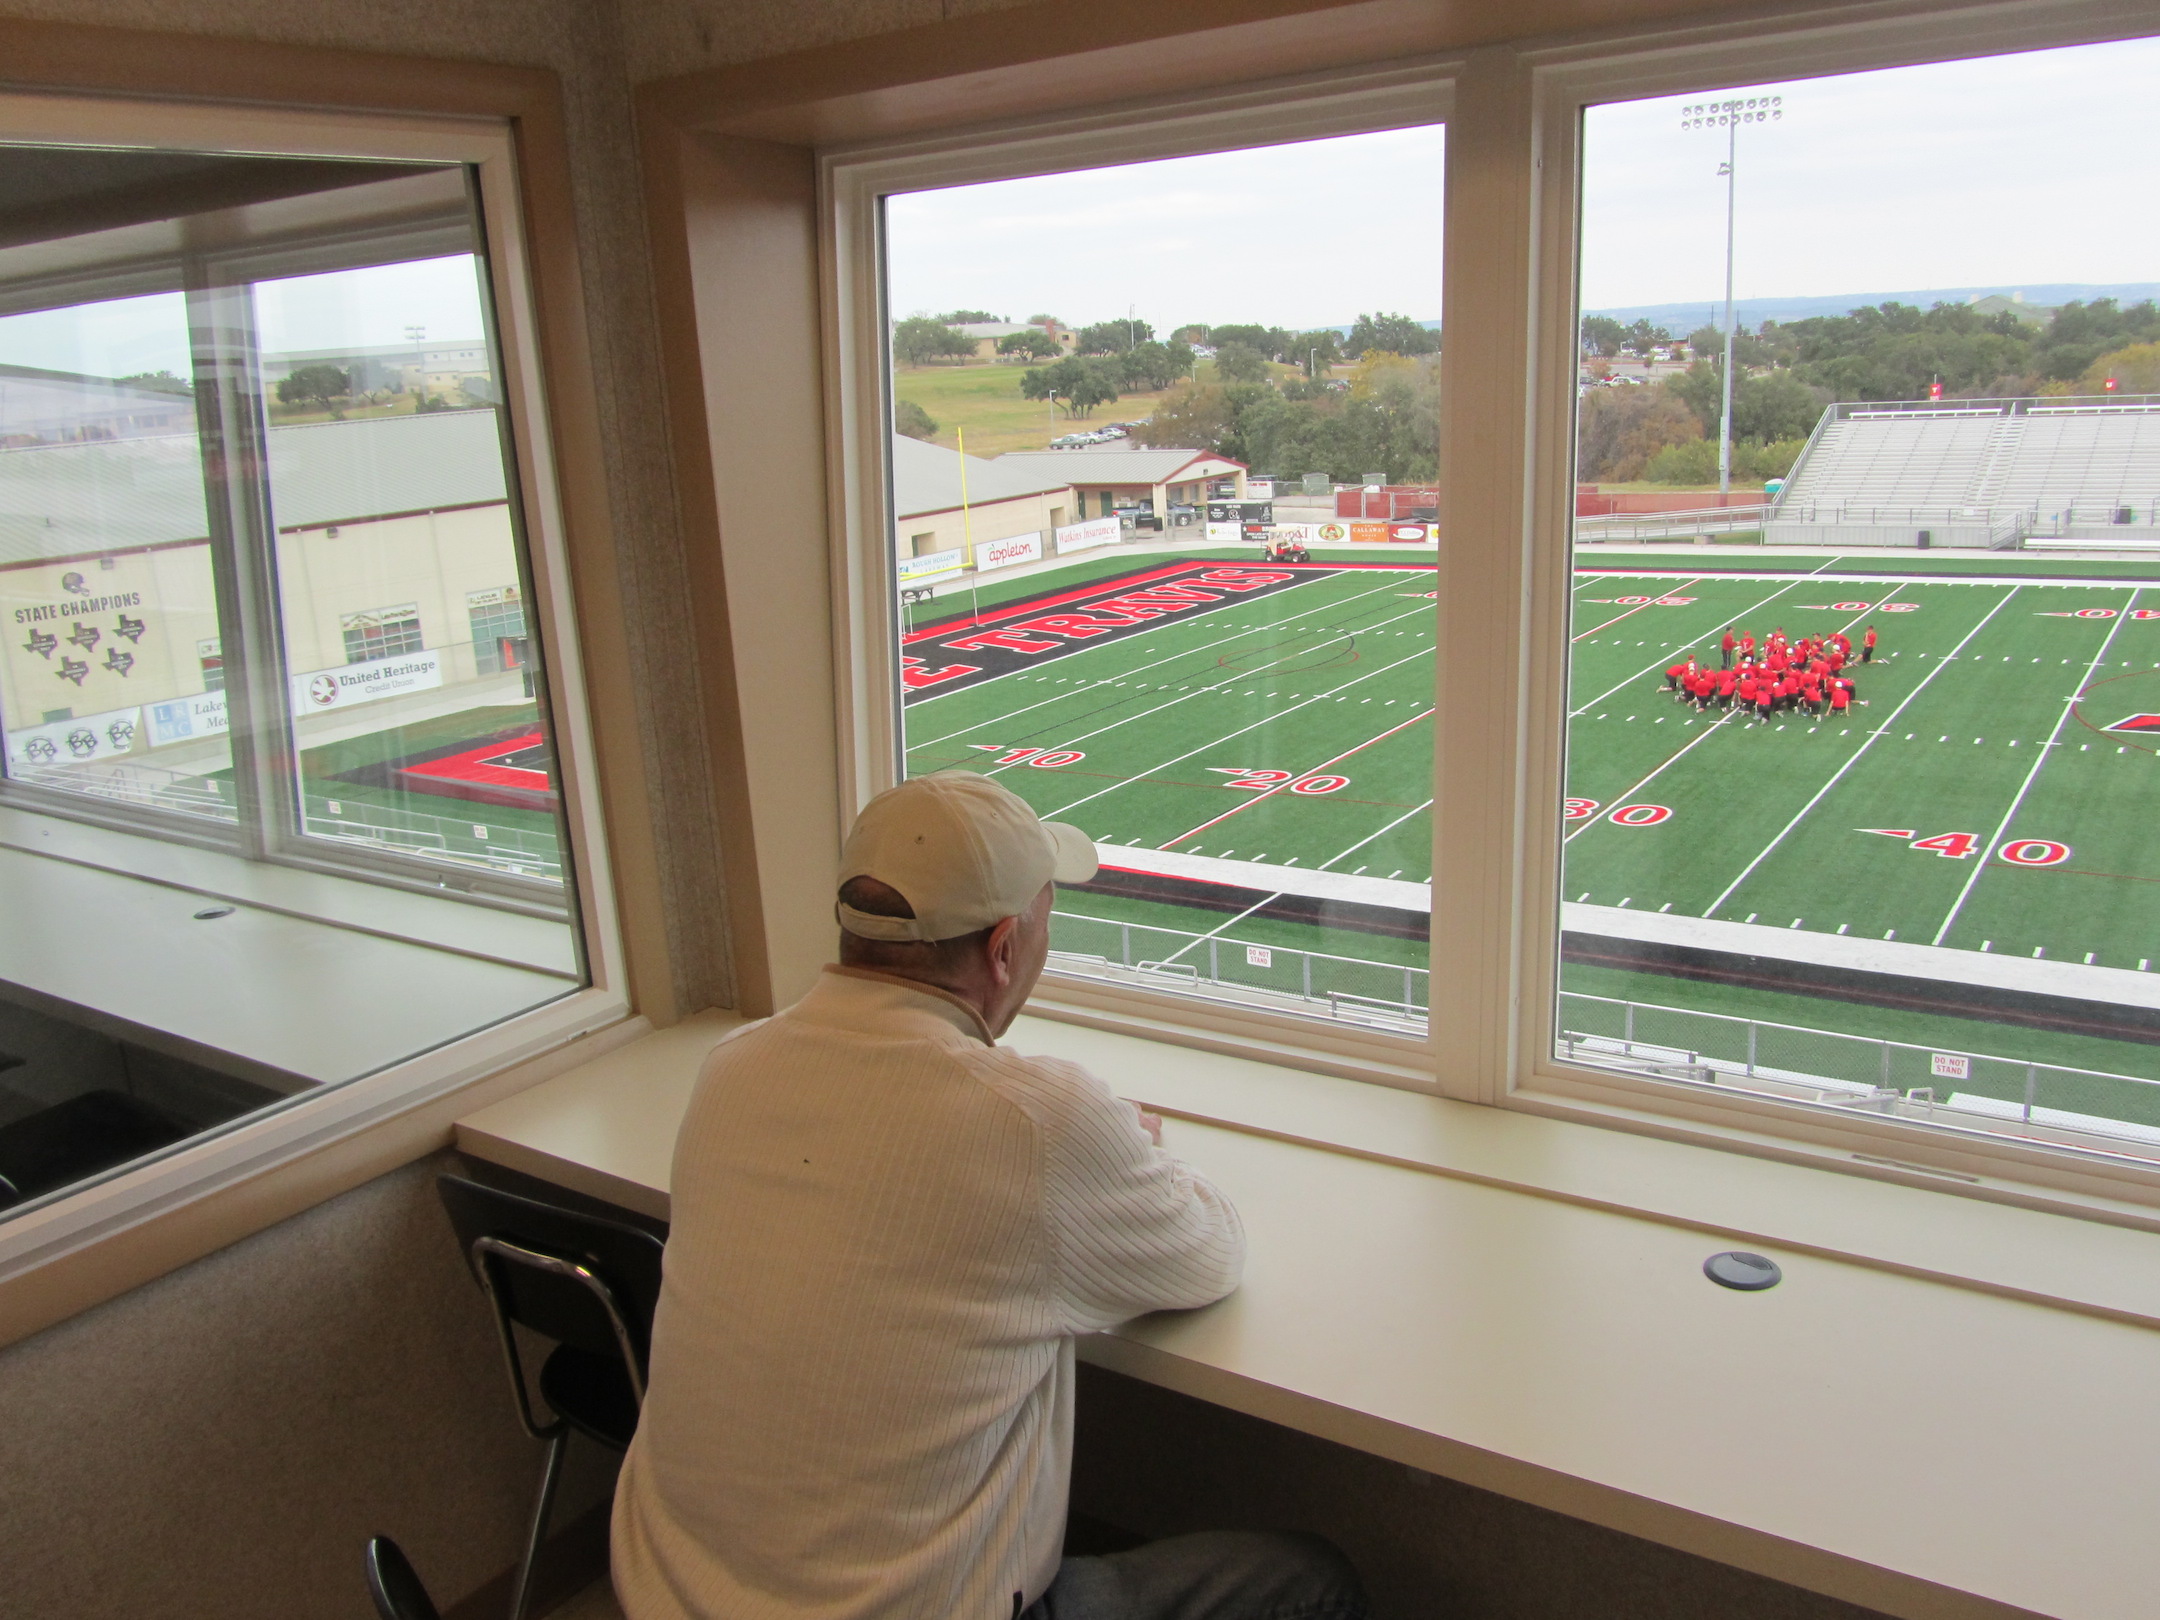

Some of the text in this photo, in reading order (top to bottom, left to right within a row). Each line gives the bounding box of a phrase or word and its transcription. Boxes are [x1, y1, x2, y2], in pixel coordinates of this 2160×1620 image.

[1058, 525, 1117, 544] Watkins Insurance
[988, 541, 1033, 565] appleton
[15, 592, 141, 624] STATE CHAMPIONS
[939, 569, 1295, 655] TRAVIS
[339, 660, 436, 687] United Heritage
[365, 678, 415, 694] Credit Union
[994, 748, 1086, 768] 10
[1223, 770, 1351, 795] 20
[1909, 832, 2071, 866] 40
[1251, 956, 1268, 965] STAND
[1258, 951, 1269, 959] NOT
[1934, 1056, 1966, 1067] DO NOT
[1936, 1065, 1963, 1075] STAND
